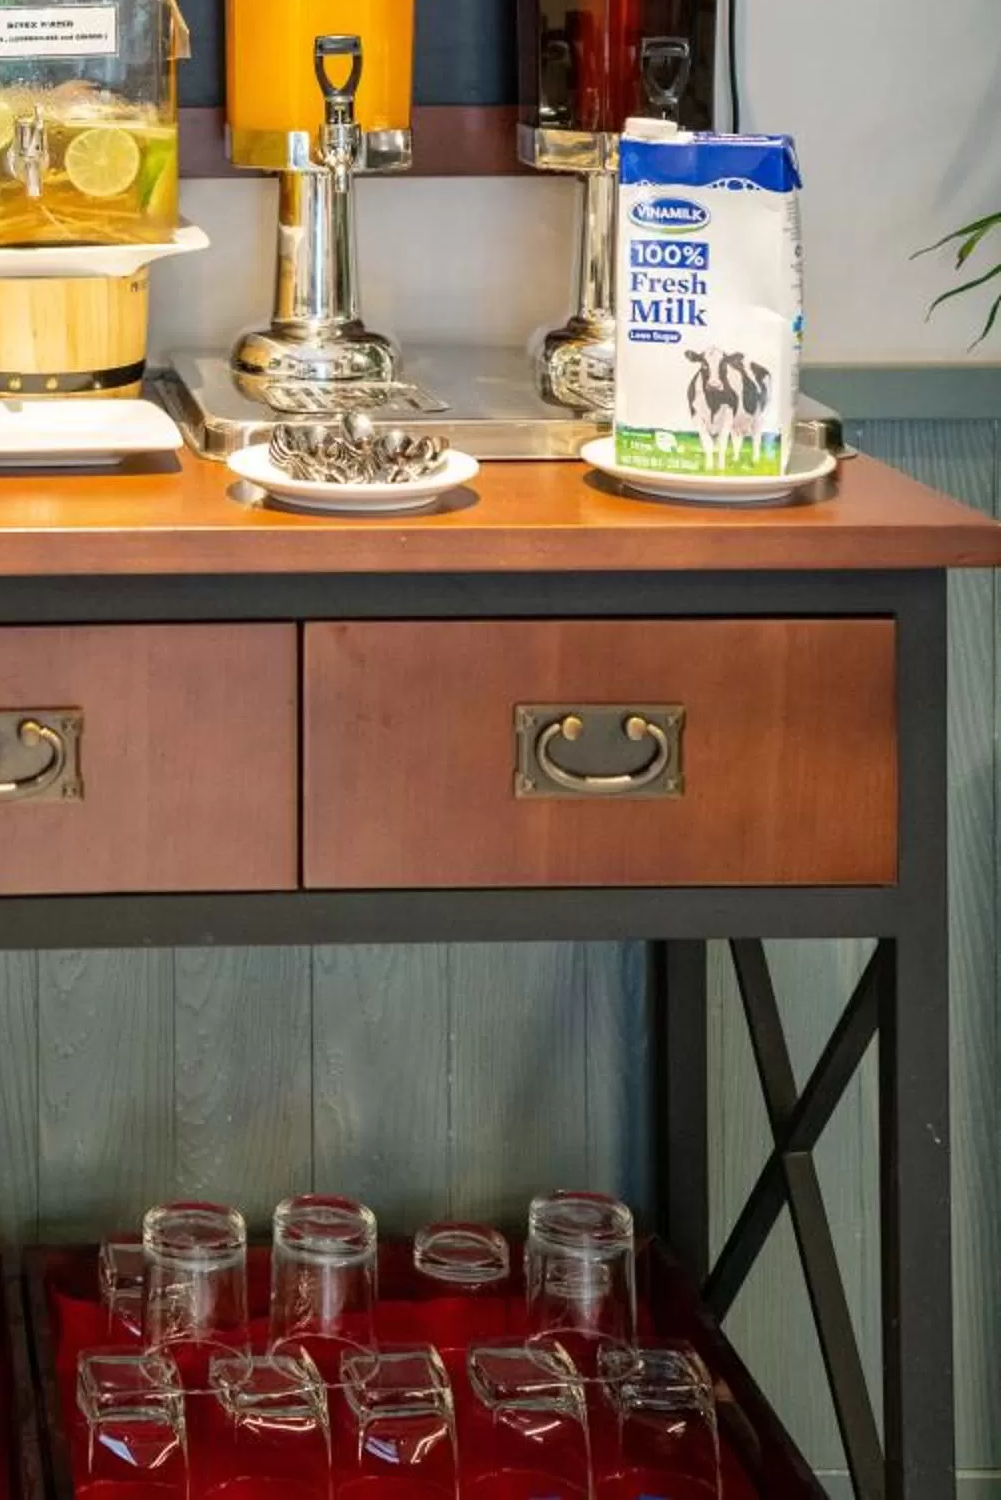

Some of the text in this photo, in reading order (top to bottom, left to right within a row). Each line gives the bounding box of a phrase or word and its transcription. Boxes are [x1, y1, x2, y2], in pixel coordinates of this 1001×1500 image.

[637, 202, 703, 221] VINAMILK
[633, 243, 705, 267] 100%
[630, 271, 707, 295] Fresh
[629, 297, 708, 327] Milk
